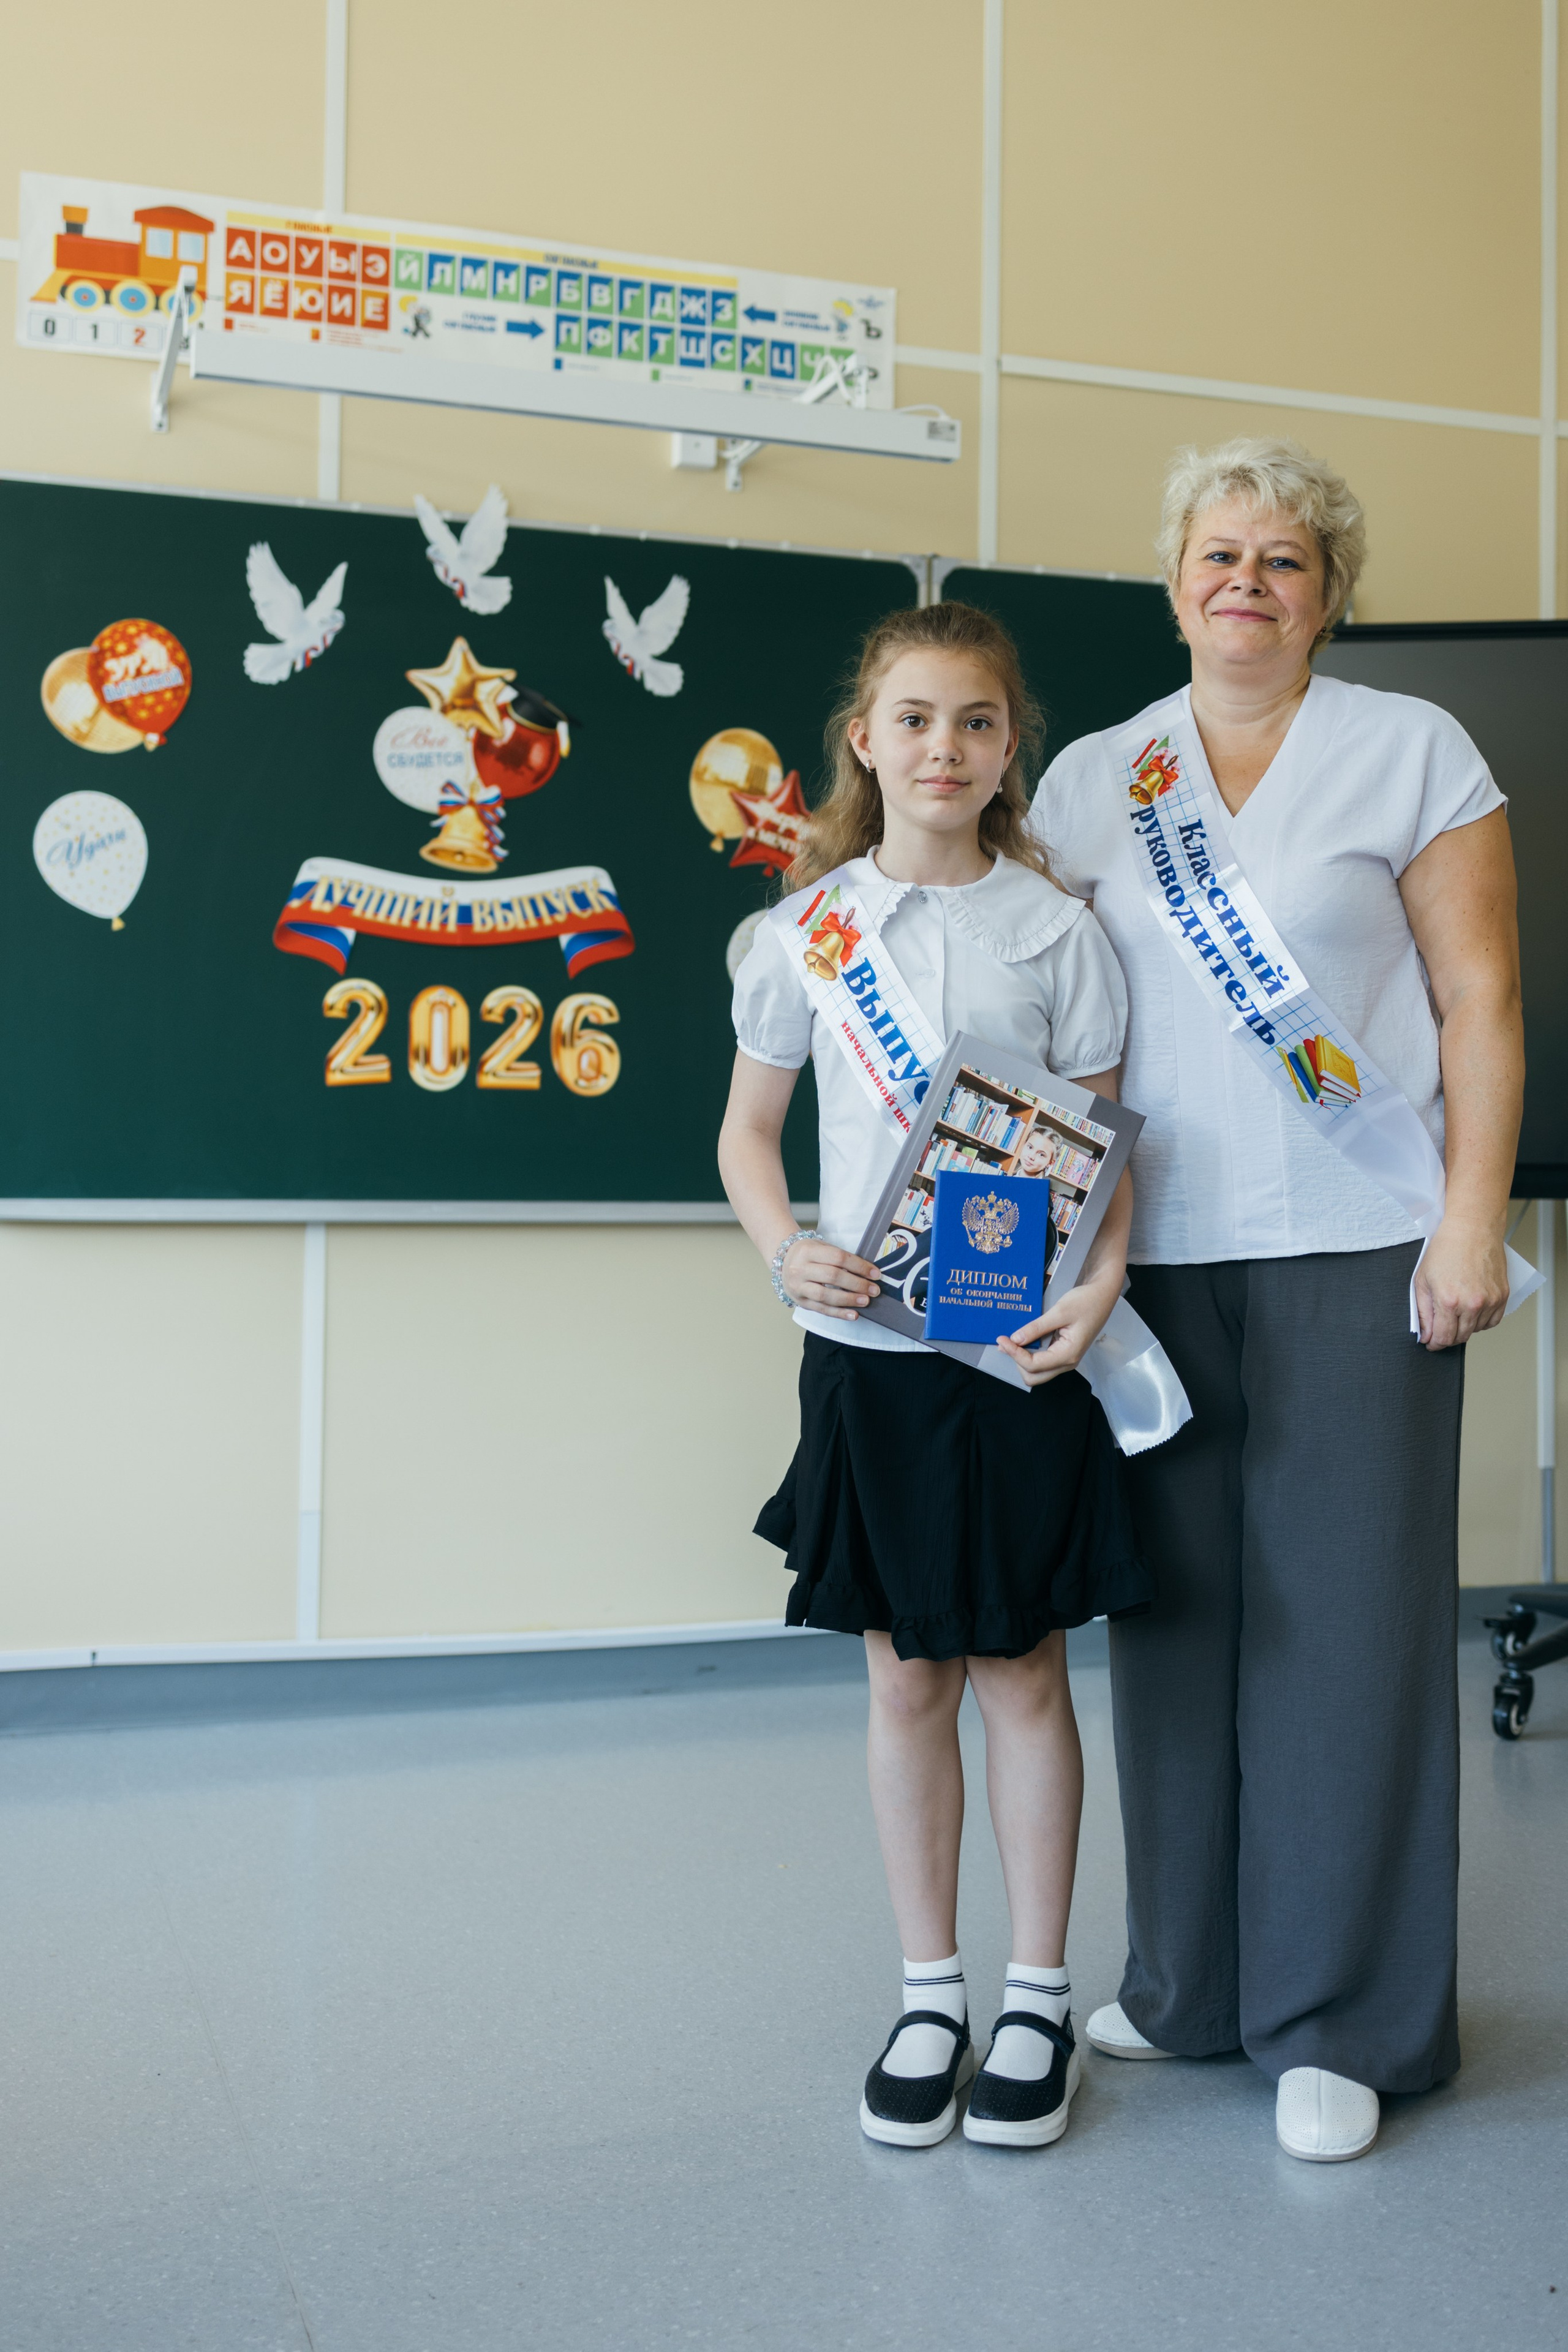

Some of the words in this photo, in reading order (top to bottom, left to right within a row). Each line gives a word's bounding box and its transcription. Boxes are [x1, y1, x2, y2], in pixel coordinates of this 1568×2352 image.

[228, 236, 254, 262] А
[262, 241, 288, 265] О
[298, 244, 320, 270] У
[329, 248, 358, 274] Ы
[364, 254, 388, 279] Э
[228, 281, 252, 305] Я
[263, 278, 285, 309] Ё
[293, 287, 323, 314] Ю
[331, 292, 353, 317] И
[364, 296, 385, 322] Е
[398, 252, 420, 283] Й
[429, 262, 453, 286] Л
[462, 265, 487, 290] М
[496, 270, 516, 294] Н
[529, 274, 548, 298] Р
[559, 278, 581, 303] Б
[590, 283, 611, 307] В
[622, 287, 641, 311] Г
[651, 291, 674, 319] Д
[680, 295, 707, 319] Ж
[714, 298, 734, 322] З
[45, 318, 56, 336] 0
[91, 323, 97, 340] 1
[134, 326, 146, 345] 2
[559, 321, 579, 345] П
[587, 325, 612, 348] Ф
[621, 329, 641, 353] К
[652, 333, 672, 355] Т
[680, 335, 707, 360] Ш
[712, 339, 734, 363] С
[744, 343, 763, 366] Х
[772, 347, 794, 376] Ц
[288, 875, 458, 933] ЛУЧШИЙ
[471, 878, 616, 933] ВЫПУСК
[1129, 805, 1277, 1046] руководитель
[1178, 818, 1290, 999] Классный
[323, 978, 620, 1096] 2026
[841, 1020, 897, 1108] начальной
[939, 1295, 993, 1308] НАЧАЛЬНОЙ
[997, 1302, 1032, 1313] ШКОЛЫ
[947, 1268, 1028, 1290] ДИПЛОМ
[966, 1289, 1022, 1302] ОКОНЧАНИИ
